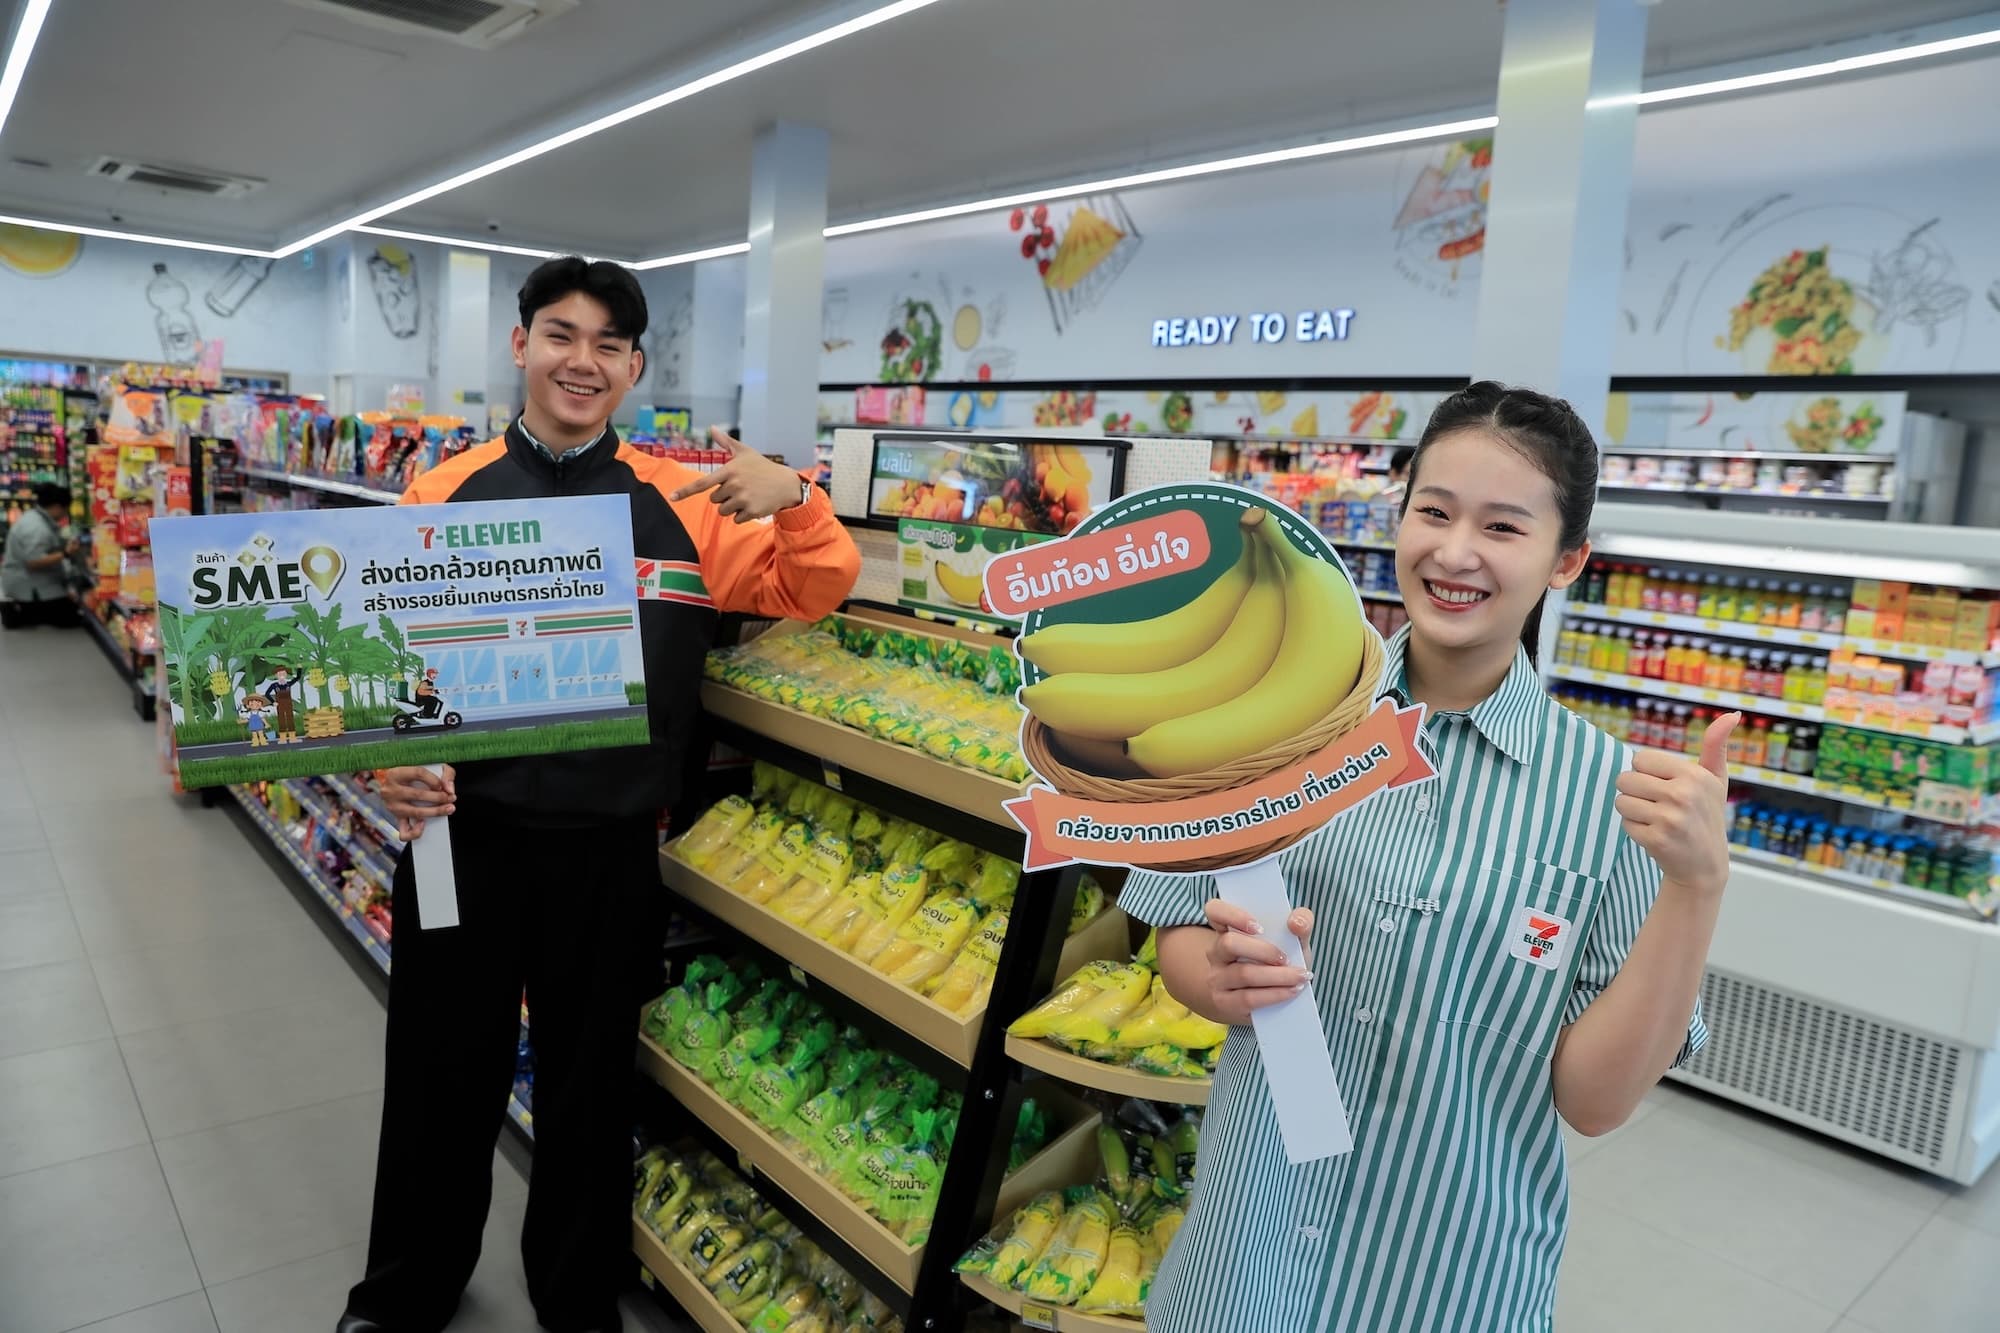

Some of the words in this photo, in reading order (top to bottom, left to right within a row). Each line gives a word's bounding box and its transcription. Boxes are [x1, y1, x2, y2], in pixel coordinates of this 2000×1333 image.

[1151, 314, 1240, 347] READY
[1250, 312, 1287, 344] TO
[1295, 308, 1355, 343] EAT
[196, 553, 226, 564] สินค้า
[361, 547, 602, 586] ส่งต่อกล้วยคุณภาพดี
[1005, 557, 1110, 603] อิ่มท้อง
[1114, 531, 1190, 575] อิ่มใจ
[193, 562, 301, 605] SME
[364, 578, 605, 613] สร้างรอยยิ้มเกษตรกรทั่วไทย
[1057, 795, 1301, 842] กล้วยจากเกษตรกรไทย
[1302, 742, 1390, 804] ที่เซเว่นฯ
[1529, 917, 1560, 958] 7
